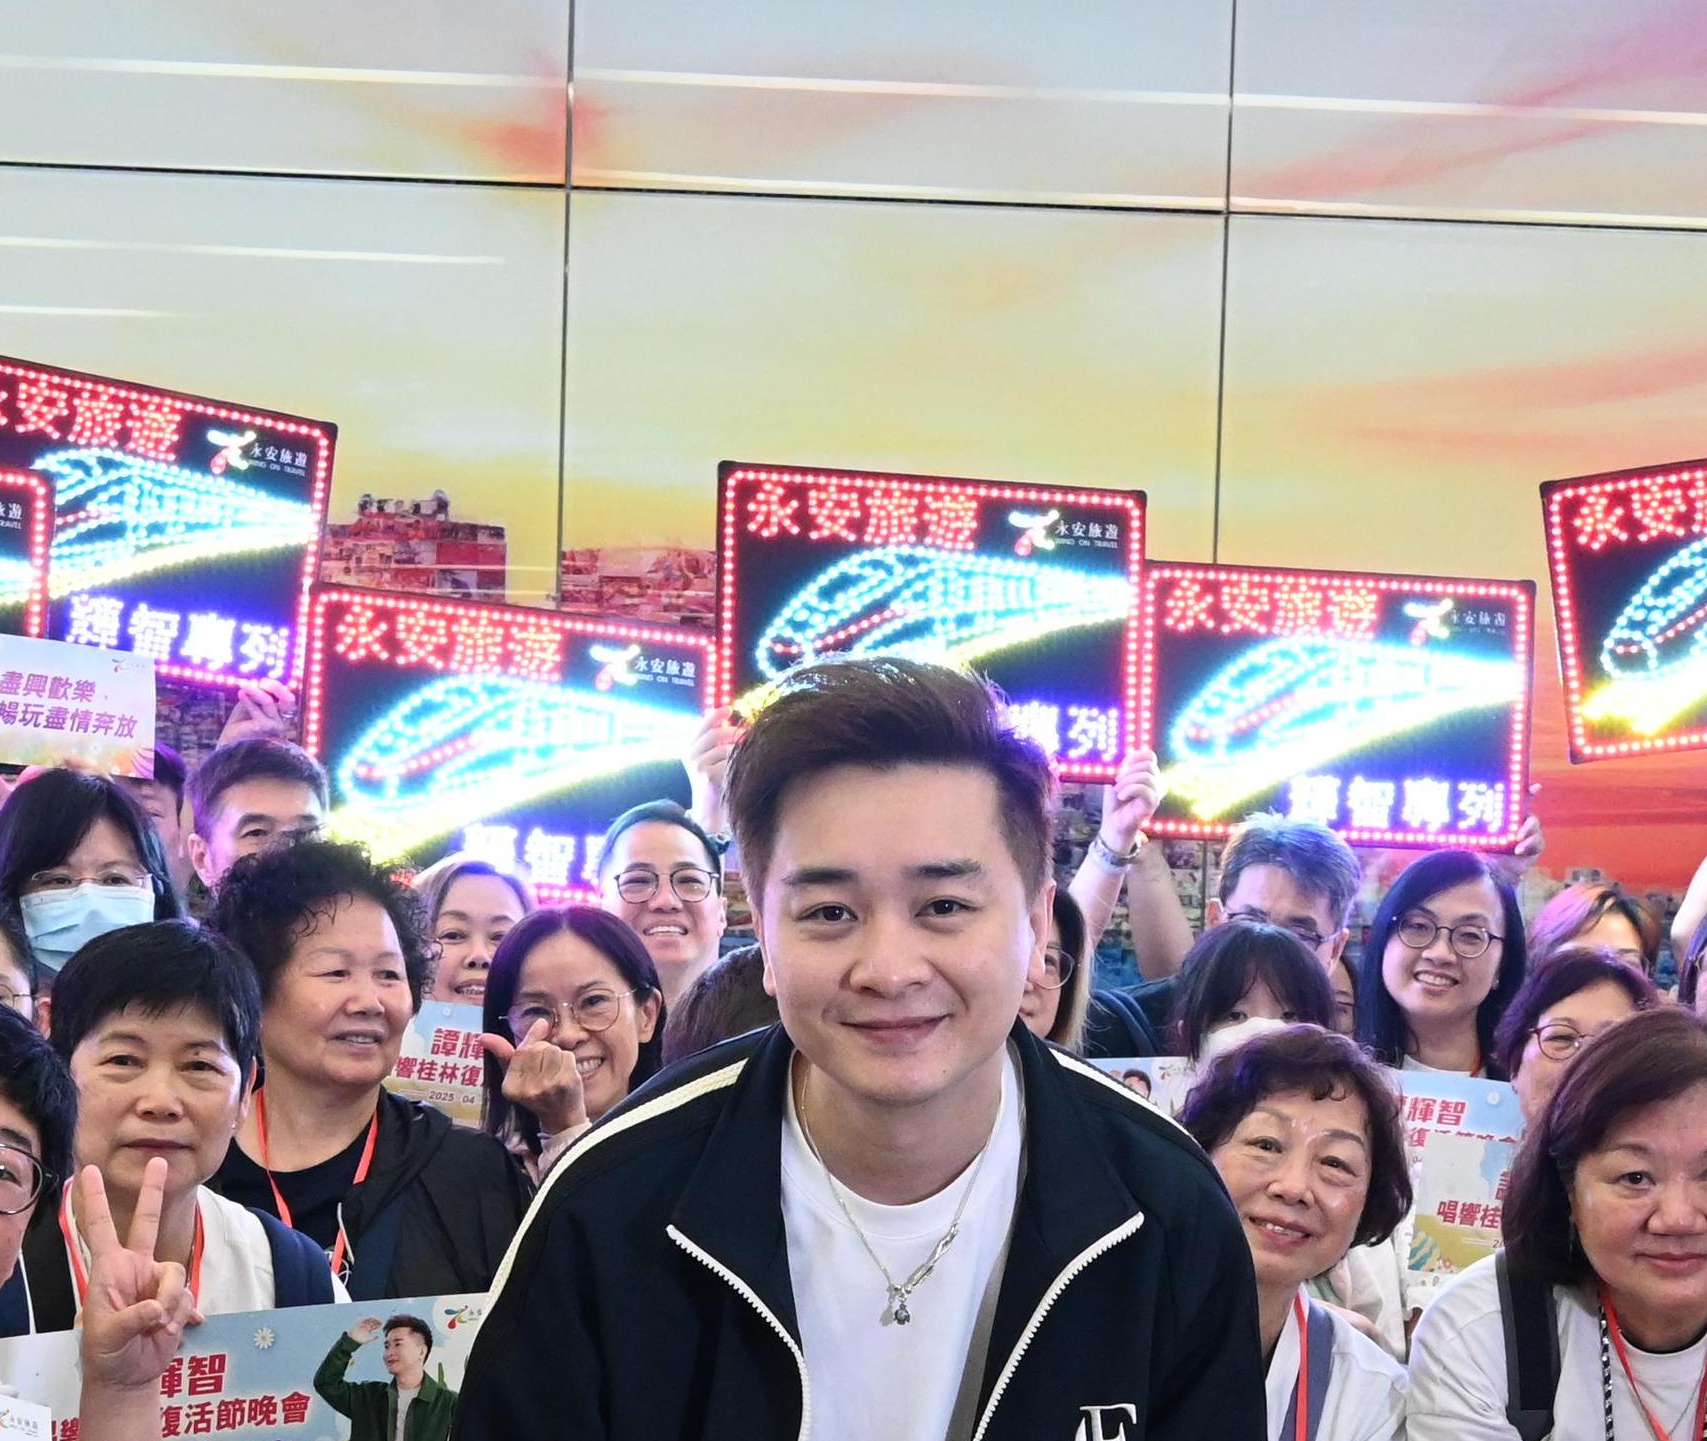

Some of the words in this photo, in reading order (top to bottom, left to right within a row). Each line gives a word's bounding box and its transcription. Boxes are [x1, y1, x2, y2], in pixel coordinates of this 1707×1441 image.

[747, 485, 979, 549] 永安旅遊
[1164, 578, 1380, 641] 永安旅遊
[335, 603, 563, 682] 永安旅遊
[429, 1091, 455, 1102] 2025
